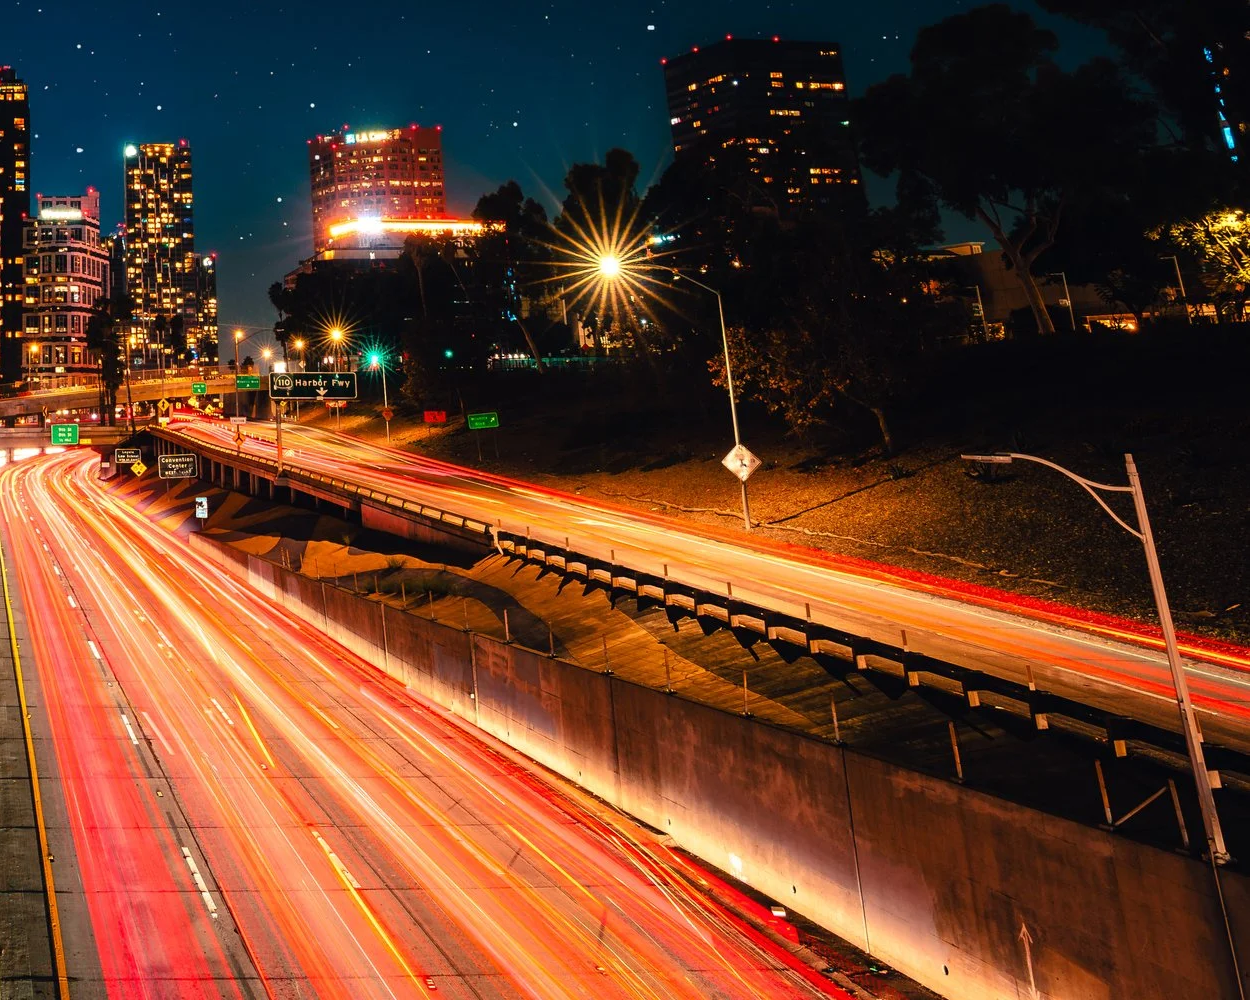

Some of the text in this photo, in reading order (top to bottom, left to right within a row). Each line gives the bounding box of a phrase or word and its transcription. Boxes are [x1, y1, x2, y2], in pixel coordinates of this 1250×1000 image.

[278, 379, 350, 388] 110 Harbor Fwy
